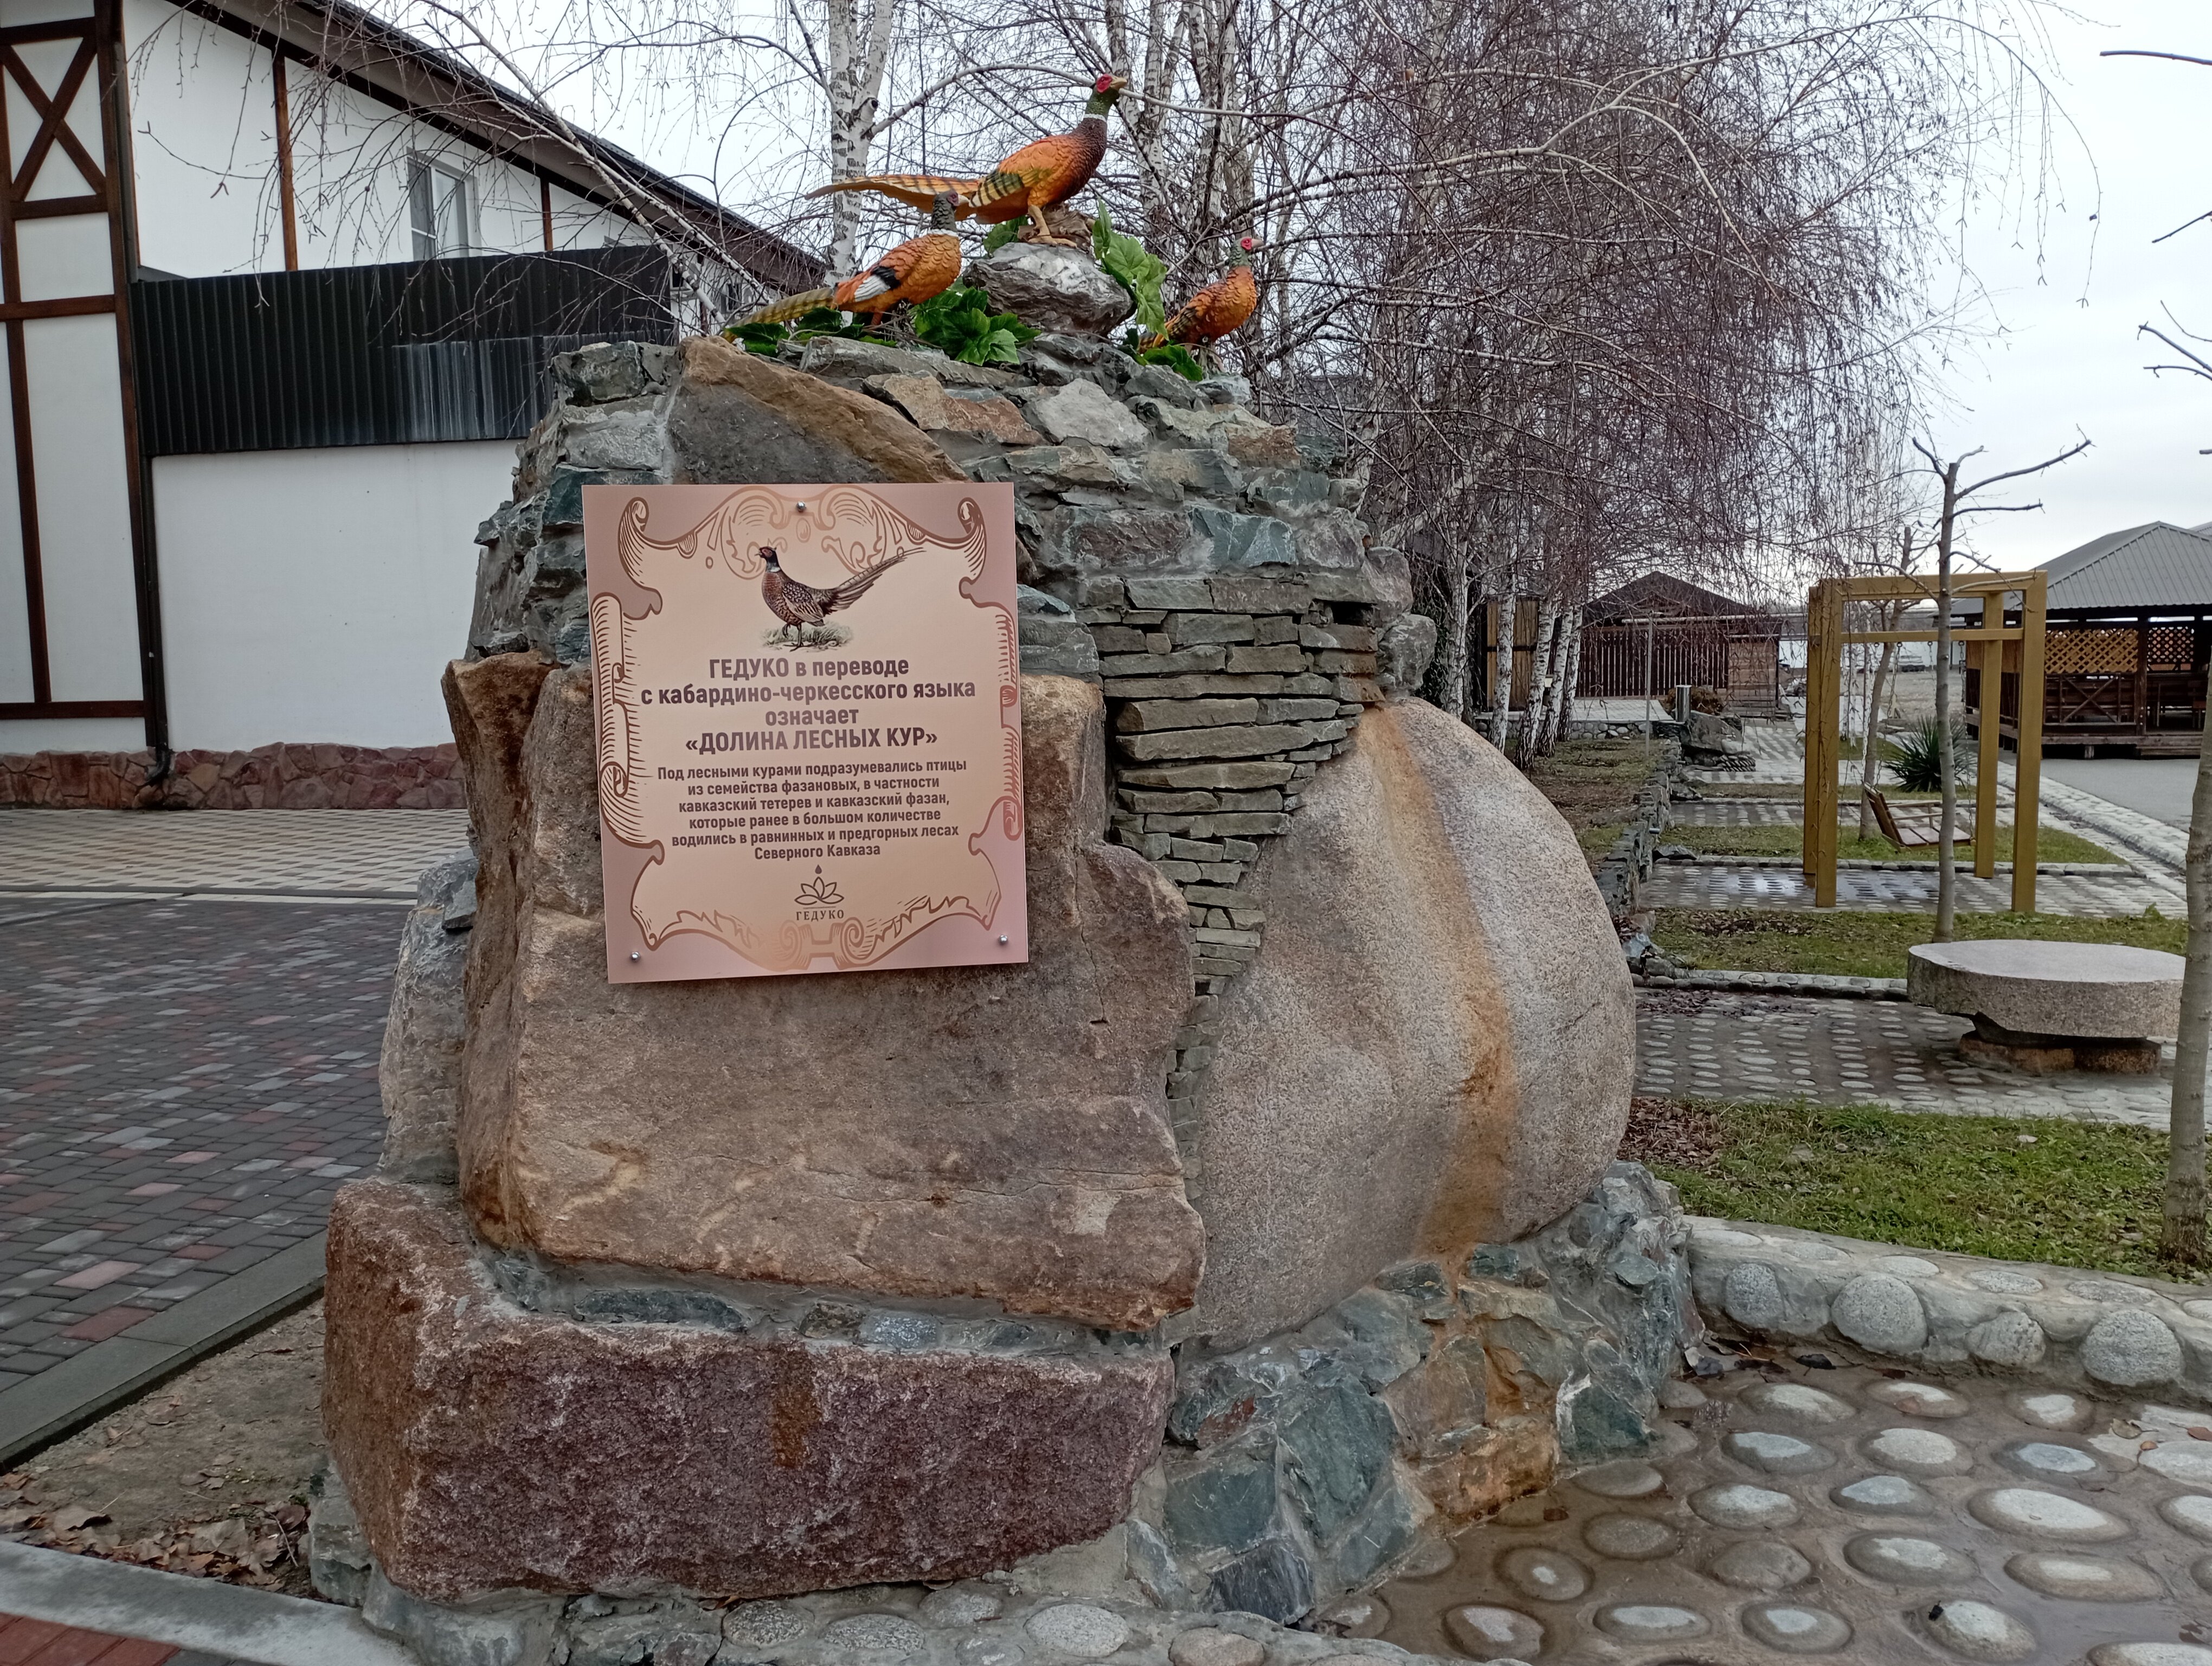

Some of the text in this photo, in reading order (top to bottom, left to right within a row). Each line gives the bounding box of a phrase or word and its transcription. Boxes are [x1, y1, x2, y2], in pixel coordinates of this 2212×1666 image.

[709, 657, 909, 681] ГЕДУКО в переводе
[641, 682, 975, 708] с кабардино-черкесского языка
[765, 709, 859, 726] означает
[685, 727, 937, 755] «ДОЛИНА ЛЕСНЫХ КУР»
[658, 760, 967, 781] Под лесными курами подразумевались птицы
[687, 777, 940, 796] из семейства фазановых, в частности
[679, 792, 950, 813] кавказский тетерев и кавказский фазан,
[689, 810, 941, 831] которые ранее в большом количестве
[672, 825, 959, 848] водились в равнинных и предгорных лесах
[754, 844, 880, 862] Северного Кавказа
[796, 909, 844, 922] ГЕДУКО
